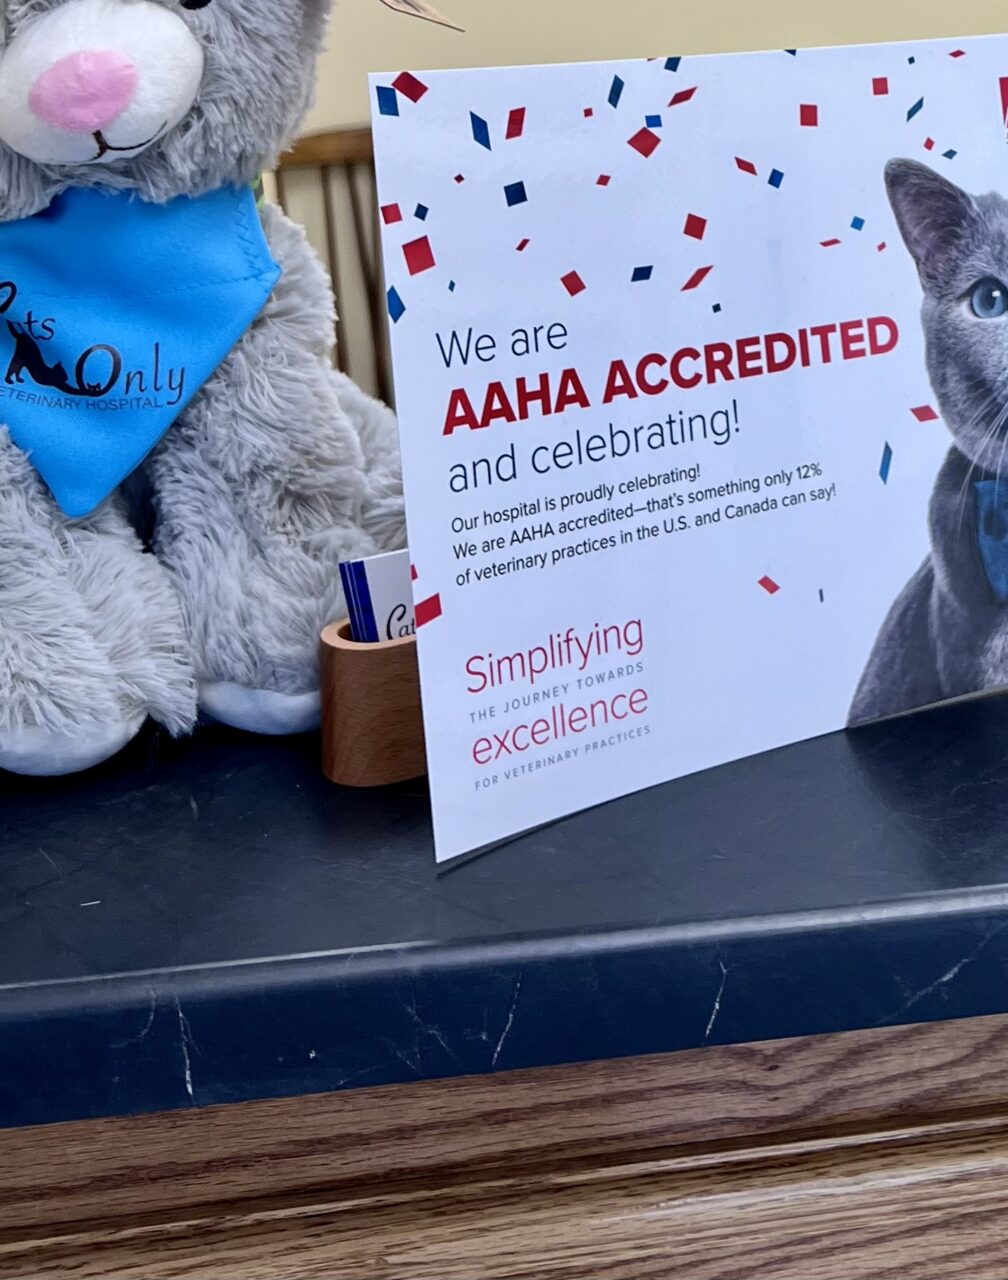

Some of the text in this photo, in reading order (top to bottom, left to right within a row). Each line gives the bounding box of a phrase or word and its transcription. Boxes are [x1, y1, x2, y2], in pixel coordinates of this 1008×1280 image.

[75, 342, 185, 406] Only
[436, 322, 568, 369] We are
[442, 315, 899, 436] AAHA ACCREDITED
[86, 396, 164, 412] HOSPITAL
[448, 399, 740, 493] and celebrating!
[451, 463, 701, 533] Our hospital is proudly celebrating!
[453, 542, 478, 560] We
[481, 536, 506, 553] are
[510, 522, 555, 546] AAHA
[688, 477, 760, 504] something
[764, 469, 793, 487] only
[796, 462, 823, 480] 12%
[456, 483, 836, 586] of veterinary practices in the U.S. and Canada can say!
[465, 619, 644, 693] Simplifying
[469, 661, 644, 724] THE JOURNEY TOWARDS
[472, 688, 649, 765] excellence
[474, 725, 651, 791] FOR VETERINARY PRACTICES
